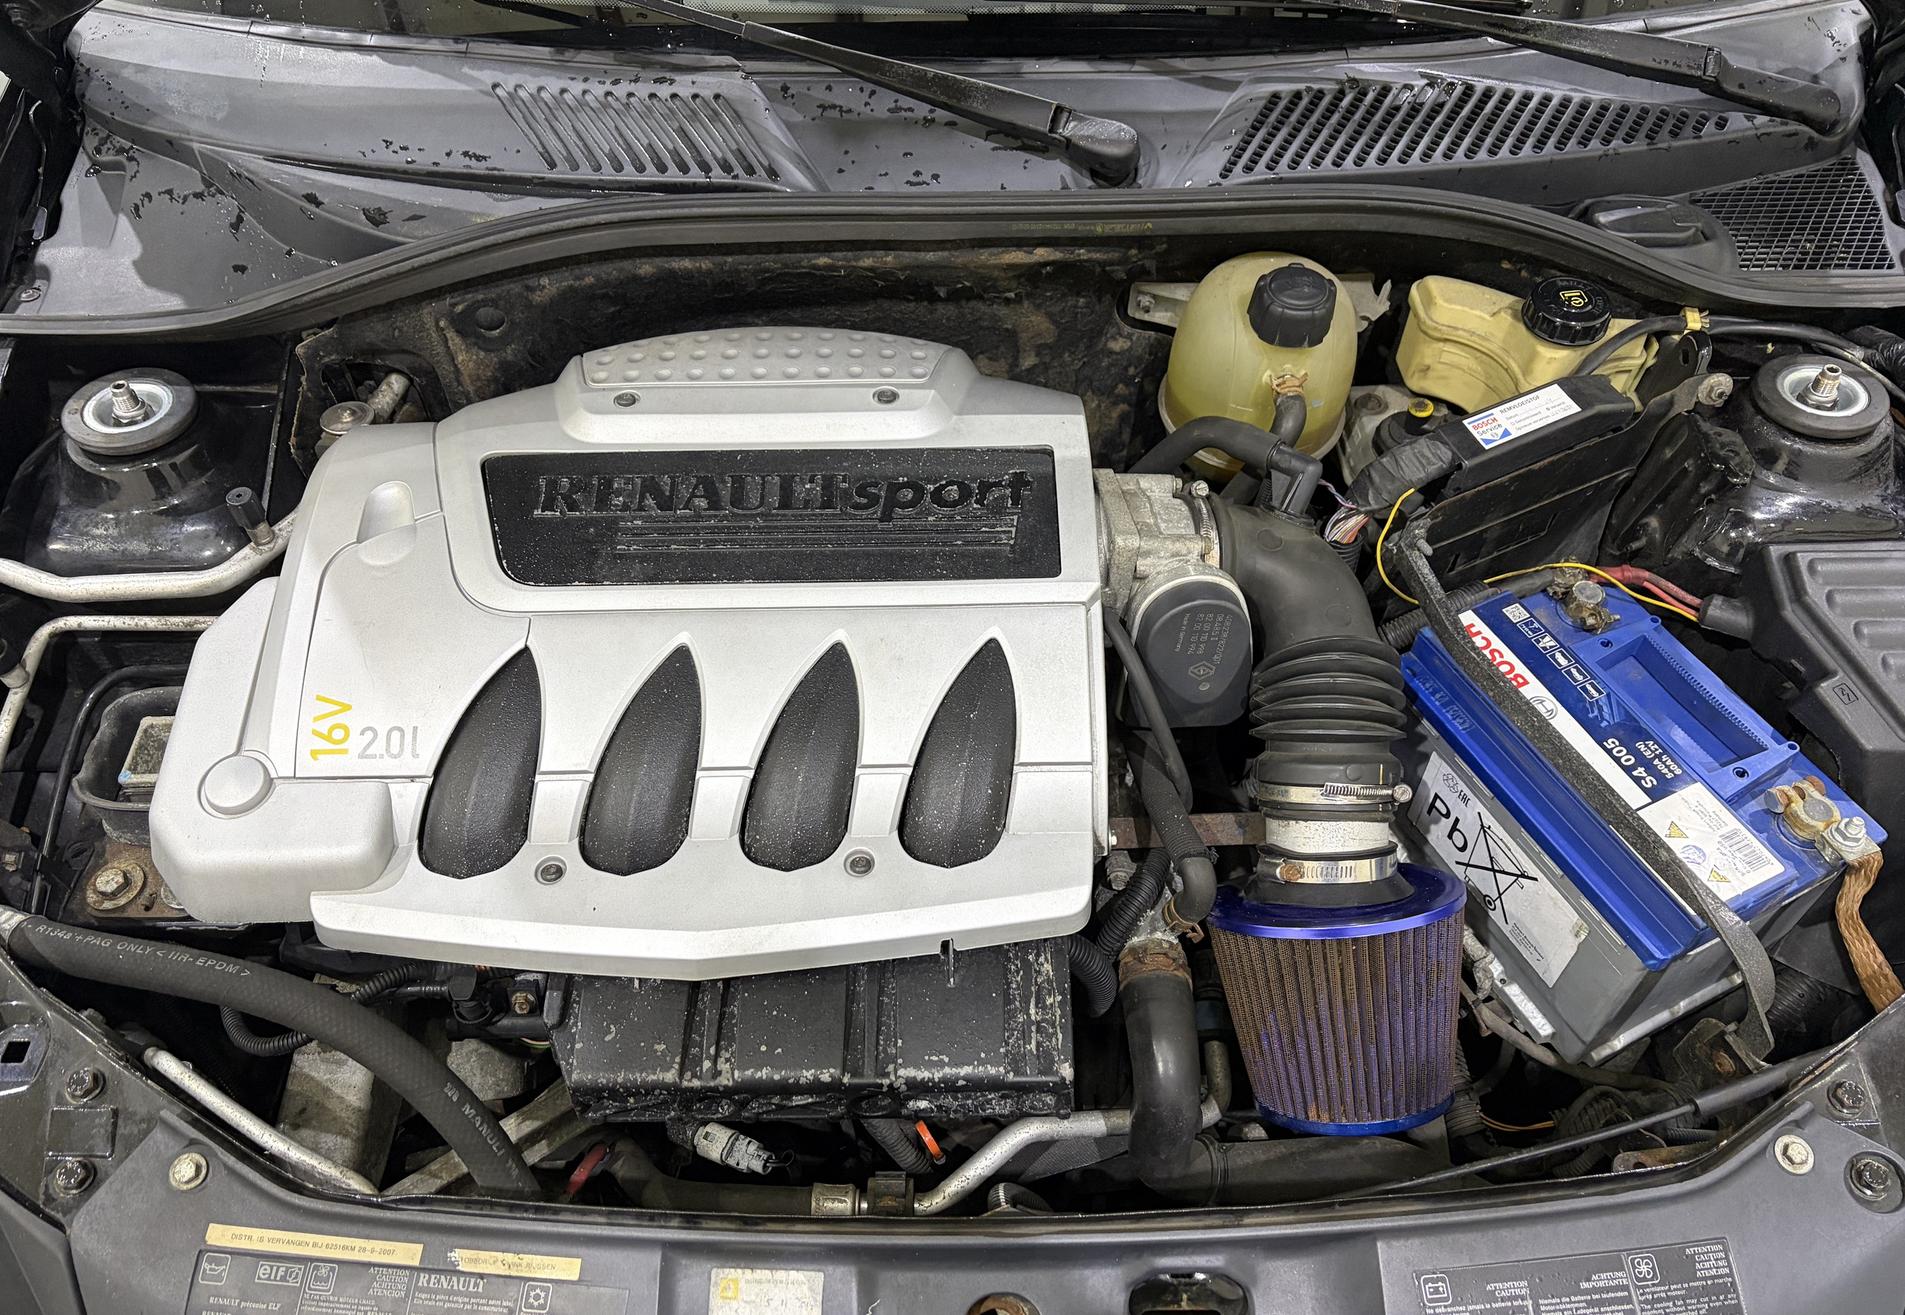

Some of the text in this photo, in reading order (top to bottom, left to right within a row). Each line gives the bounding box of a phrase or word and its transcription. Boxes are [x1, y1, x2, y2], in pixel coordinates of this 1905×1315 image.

[1472, 417, 1499, 431] BOSCH
[1477, 423, 1502, 436] Service
[1464, 622, 1530, 689] BOSCH
[309, 694, 352, 761] 16V
[1602, 737, 1657, 788] S4 005
[1635, 741, 1675, 779] 540A (EN)
[1645, 740, 1683, 775] 60Ah 12V
[1426, 792, 1469, 853] Pb
[117, 941, 154, 955] ONLY
[462, 1103, 505, 1156] MANULI
[267, 1236, 310, 1248] VERVANGEN
[1685, 1244, 1723, 1255] ATTENTION
[1695, 1251, 1726, 1261] CAUTION
[1695, 1259, 1728, 1270] ACHTUNG
[258, 1264, 286, 1281] elf
[368, 1266, 411, 1276] ATTENTION
[1591, 1271, 1626, 1281] ACHTUNG
[376, 1274, 409, 1284] CAUTION
[418, 1273, 487, 1293] RENAULT
[1580, 1278, 1629, 1289] IMPORTANTE
[371, 1281, 407, 1291] ACHTUNG
[1486, 1280, 1528, 1291] ATTENTION
[1495, 1288, 1530, 1297] CAUTION
[209, 1296, 240, 1306] RENAULT
